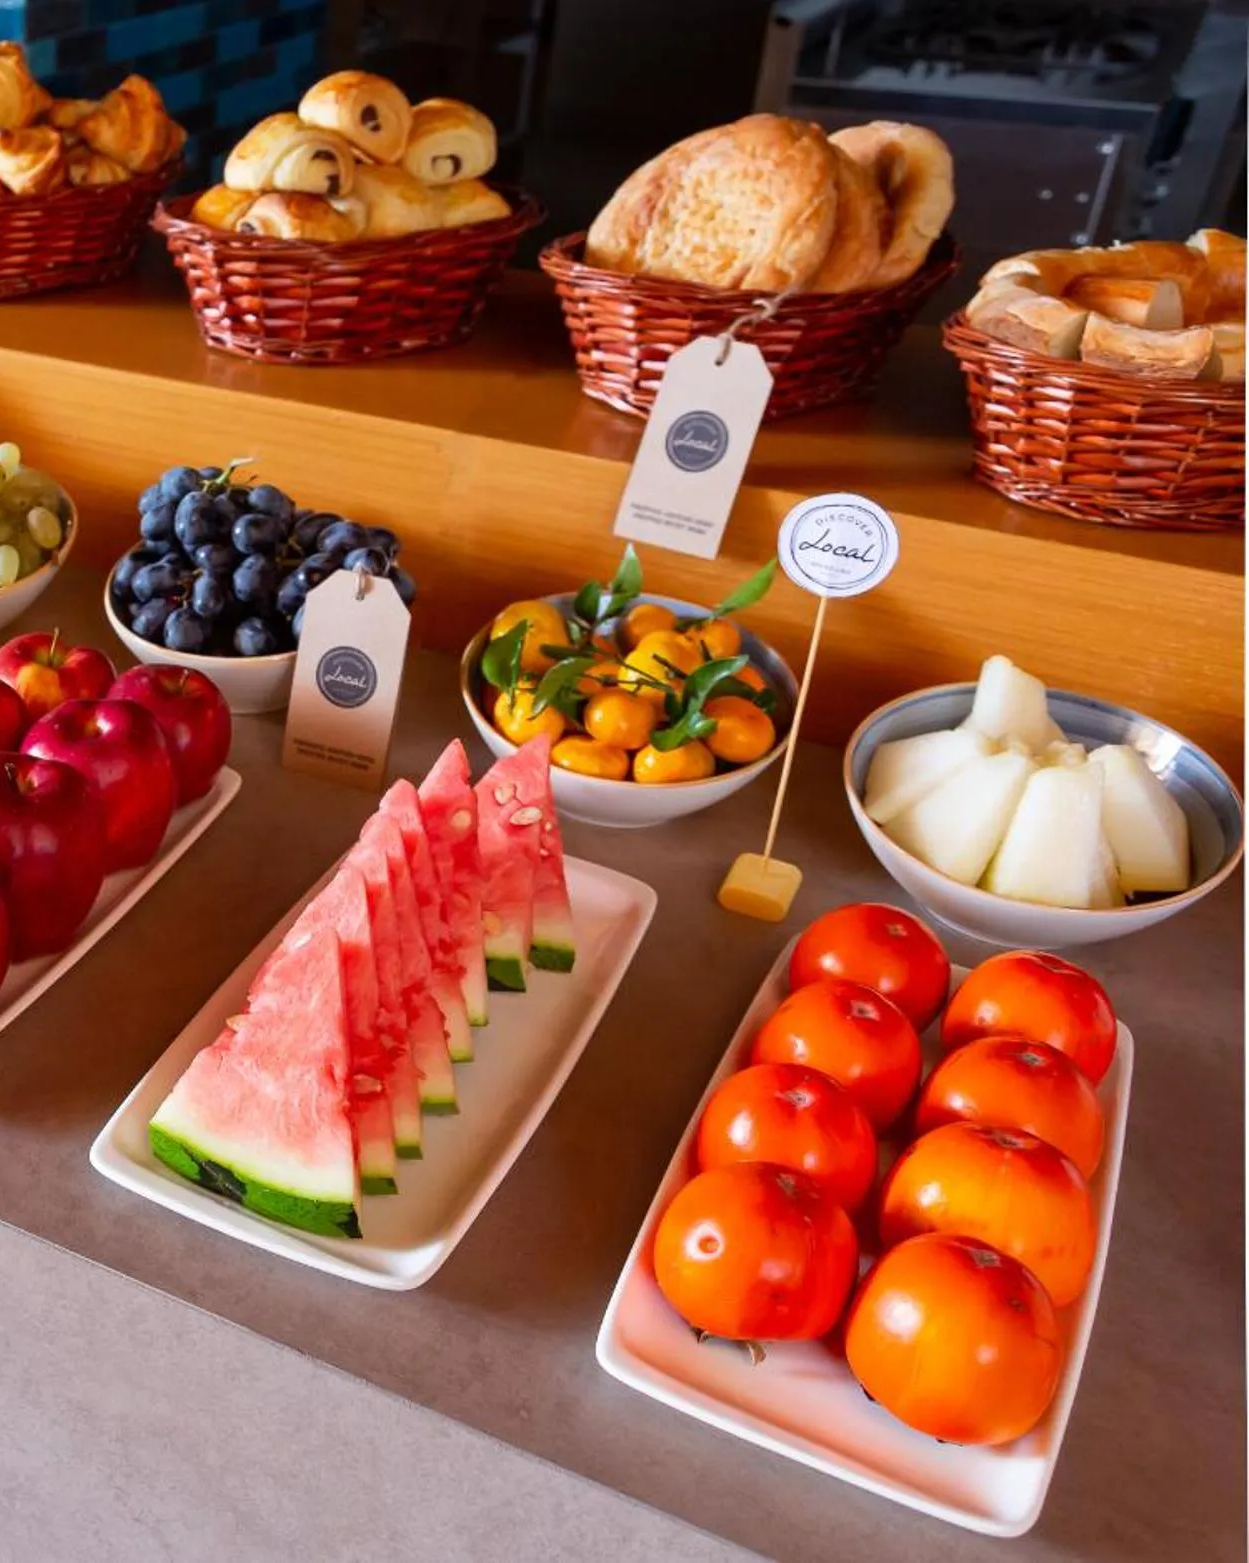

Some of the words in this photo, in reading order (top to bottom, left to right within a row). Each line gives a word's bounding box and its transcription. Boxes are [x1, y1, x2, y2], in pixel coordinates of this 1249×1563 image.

[673, 430, 718, 453] Local
[814, 512, 873, 537] DISCOVER
[798, 528, 876, 562] Local
[324, 665, 367, 689] Local
